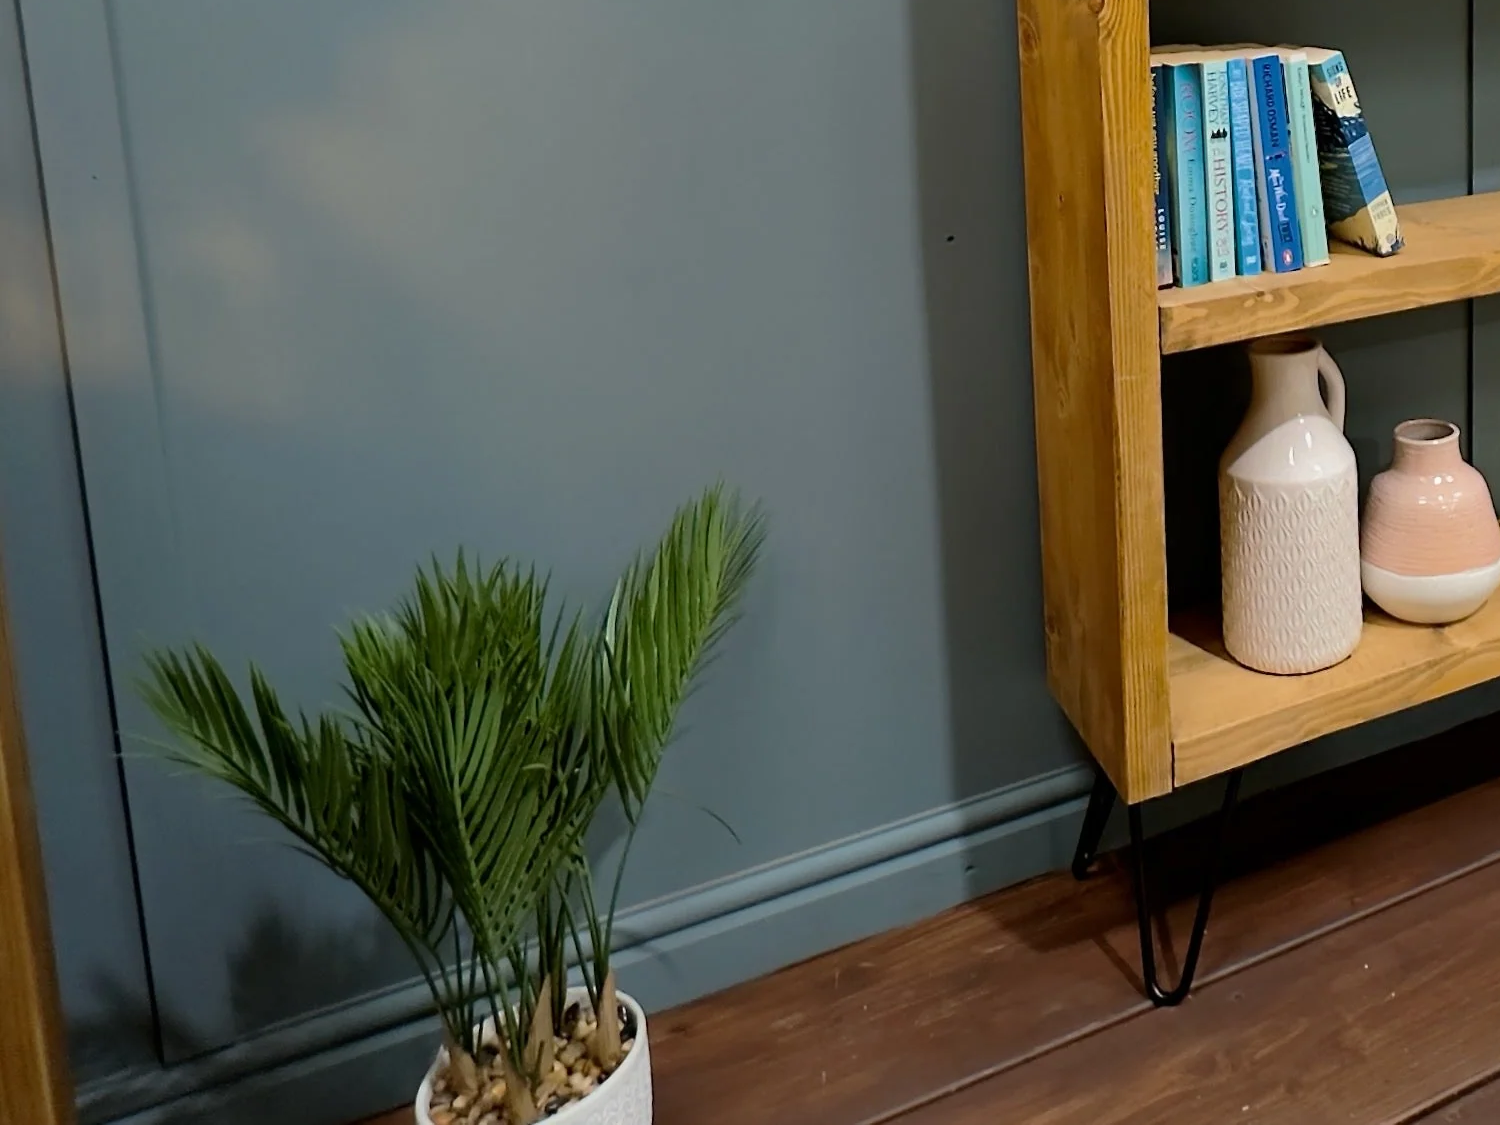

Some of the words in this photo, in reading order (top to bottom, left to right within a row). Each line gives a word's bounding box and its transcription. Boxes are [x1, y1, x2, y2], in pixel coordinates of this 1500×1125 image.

[1207, 70, 1220, 126] HARVEY
[1262, 63, 1276, 108] RICHARD
[1334, 85, 1352, 105] LIFE
[1267, 108, 1280, 148] OSMAN
[1213, 157, 1230, 232] HISTORY
[1157, 208, 1167, 250] LOUISE
